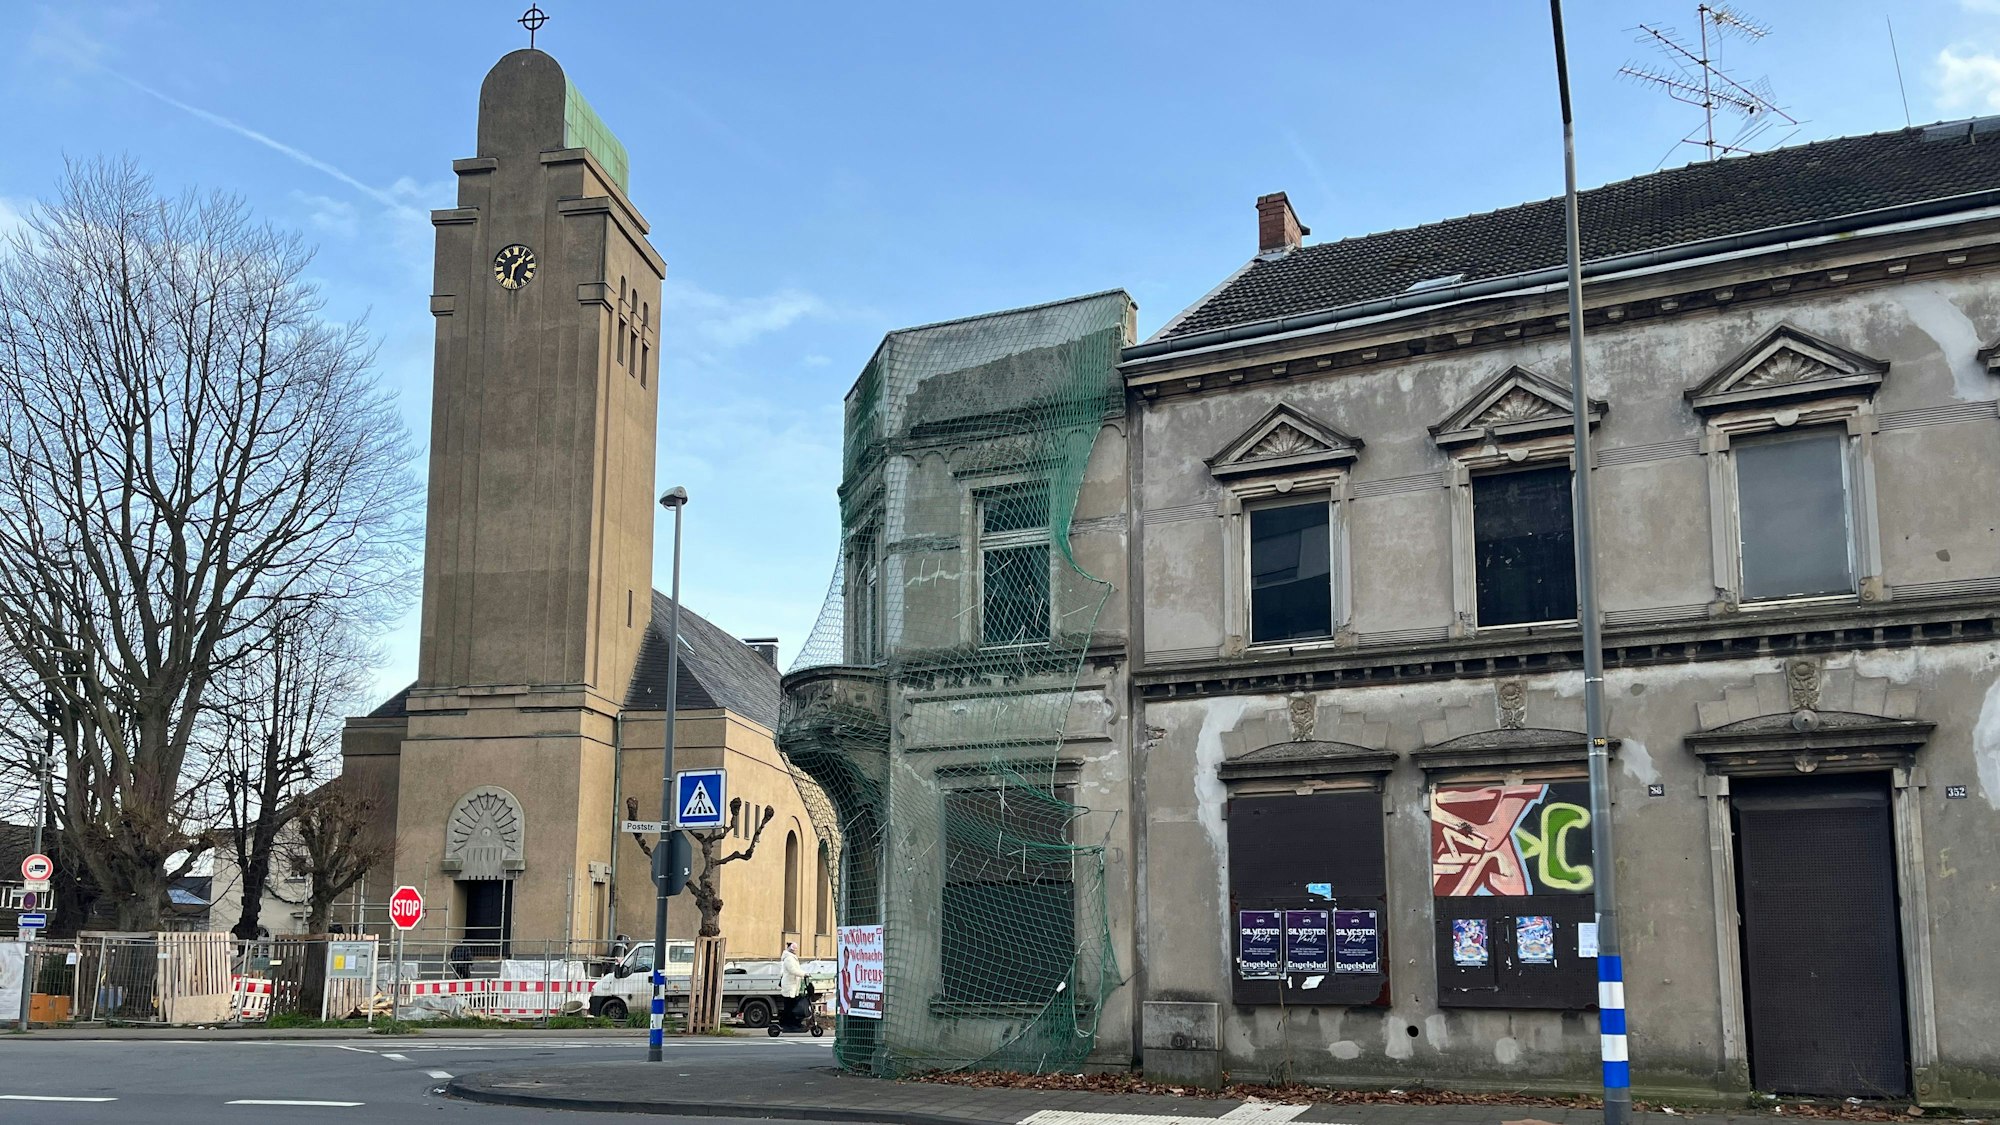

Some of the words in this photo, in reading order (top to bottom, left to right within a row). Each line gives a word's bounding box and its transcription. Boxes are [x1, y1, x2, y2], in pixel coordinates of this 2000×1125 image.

[1947, 787, 1965, 797] 352
[627, 822, 655, 831] Poststr.
[393, 899, 420, 917] STOP
[849, 928, 875, 947] Kölner
[1288, 961, 1327, 970] Engelshof
[1336, 962, 1376, 971] Engelshof
[855, 963, 883, 985] Circus
